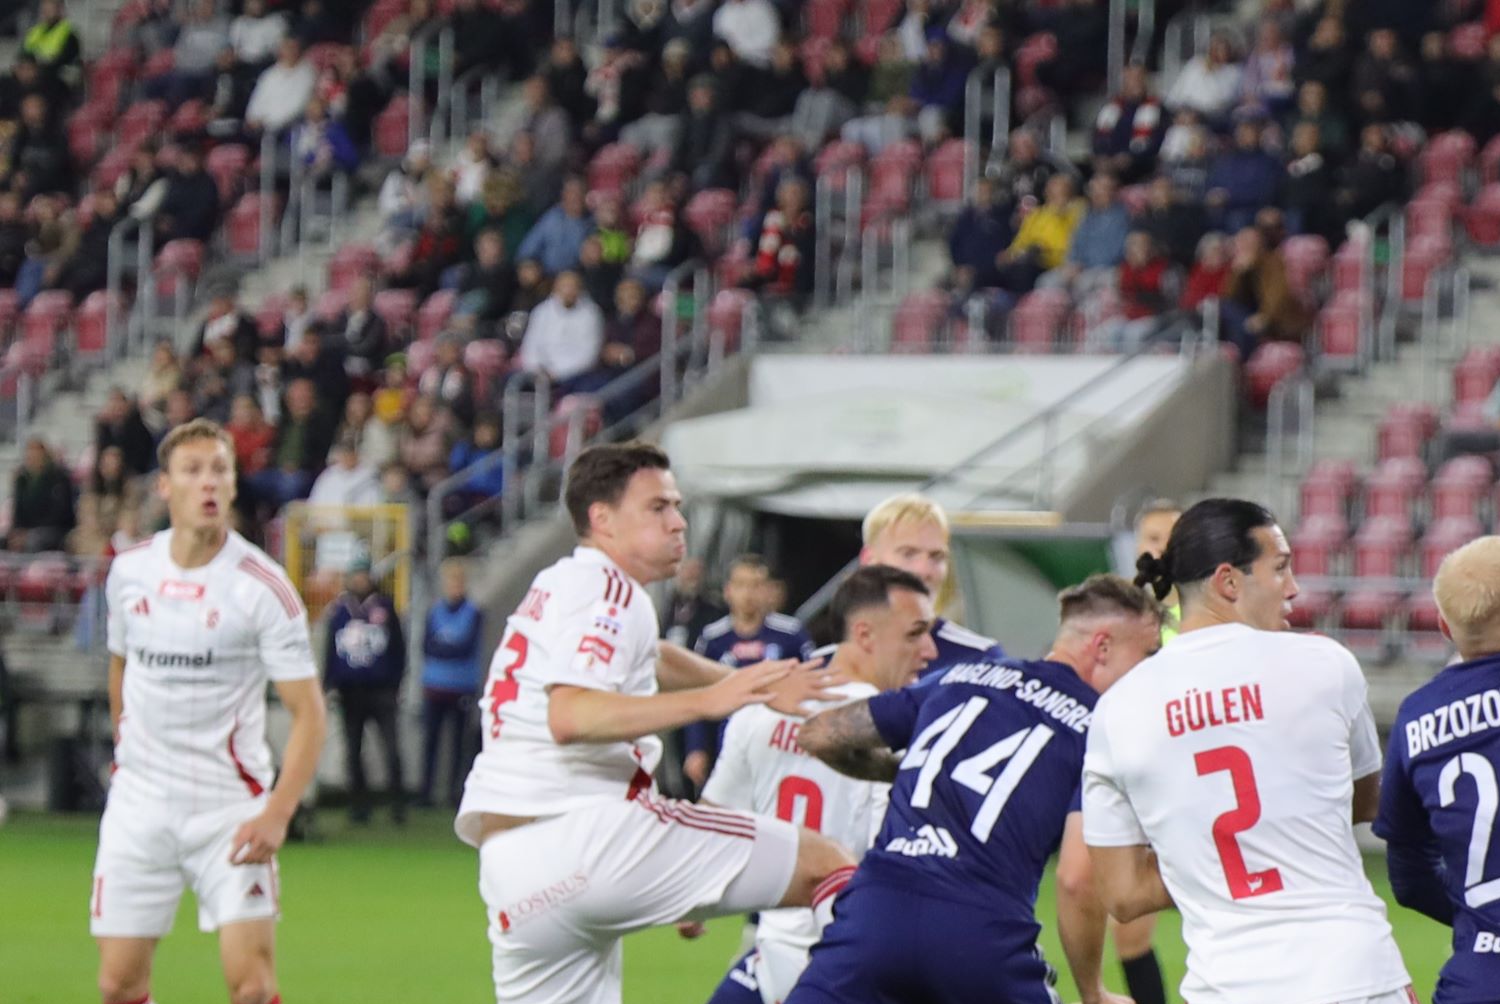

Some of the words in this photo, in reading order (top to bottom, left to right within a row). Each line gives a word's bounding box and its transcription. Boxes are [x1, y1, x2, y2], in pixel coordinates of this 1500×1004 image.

[899, 695, 1056, 845] 44
[1165, 684, 1264, 738] GÜLEN
[1193, 744, 1285, 900] 2
